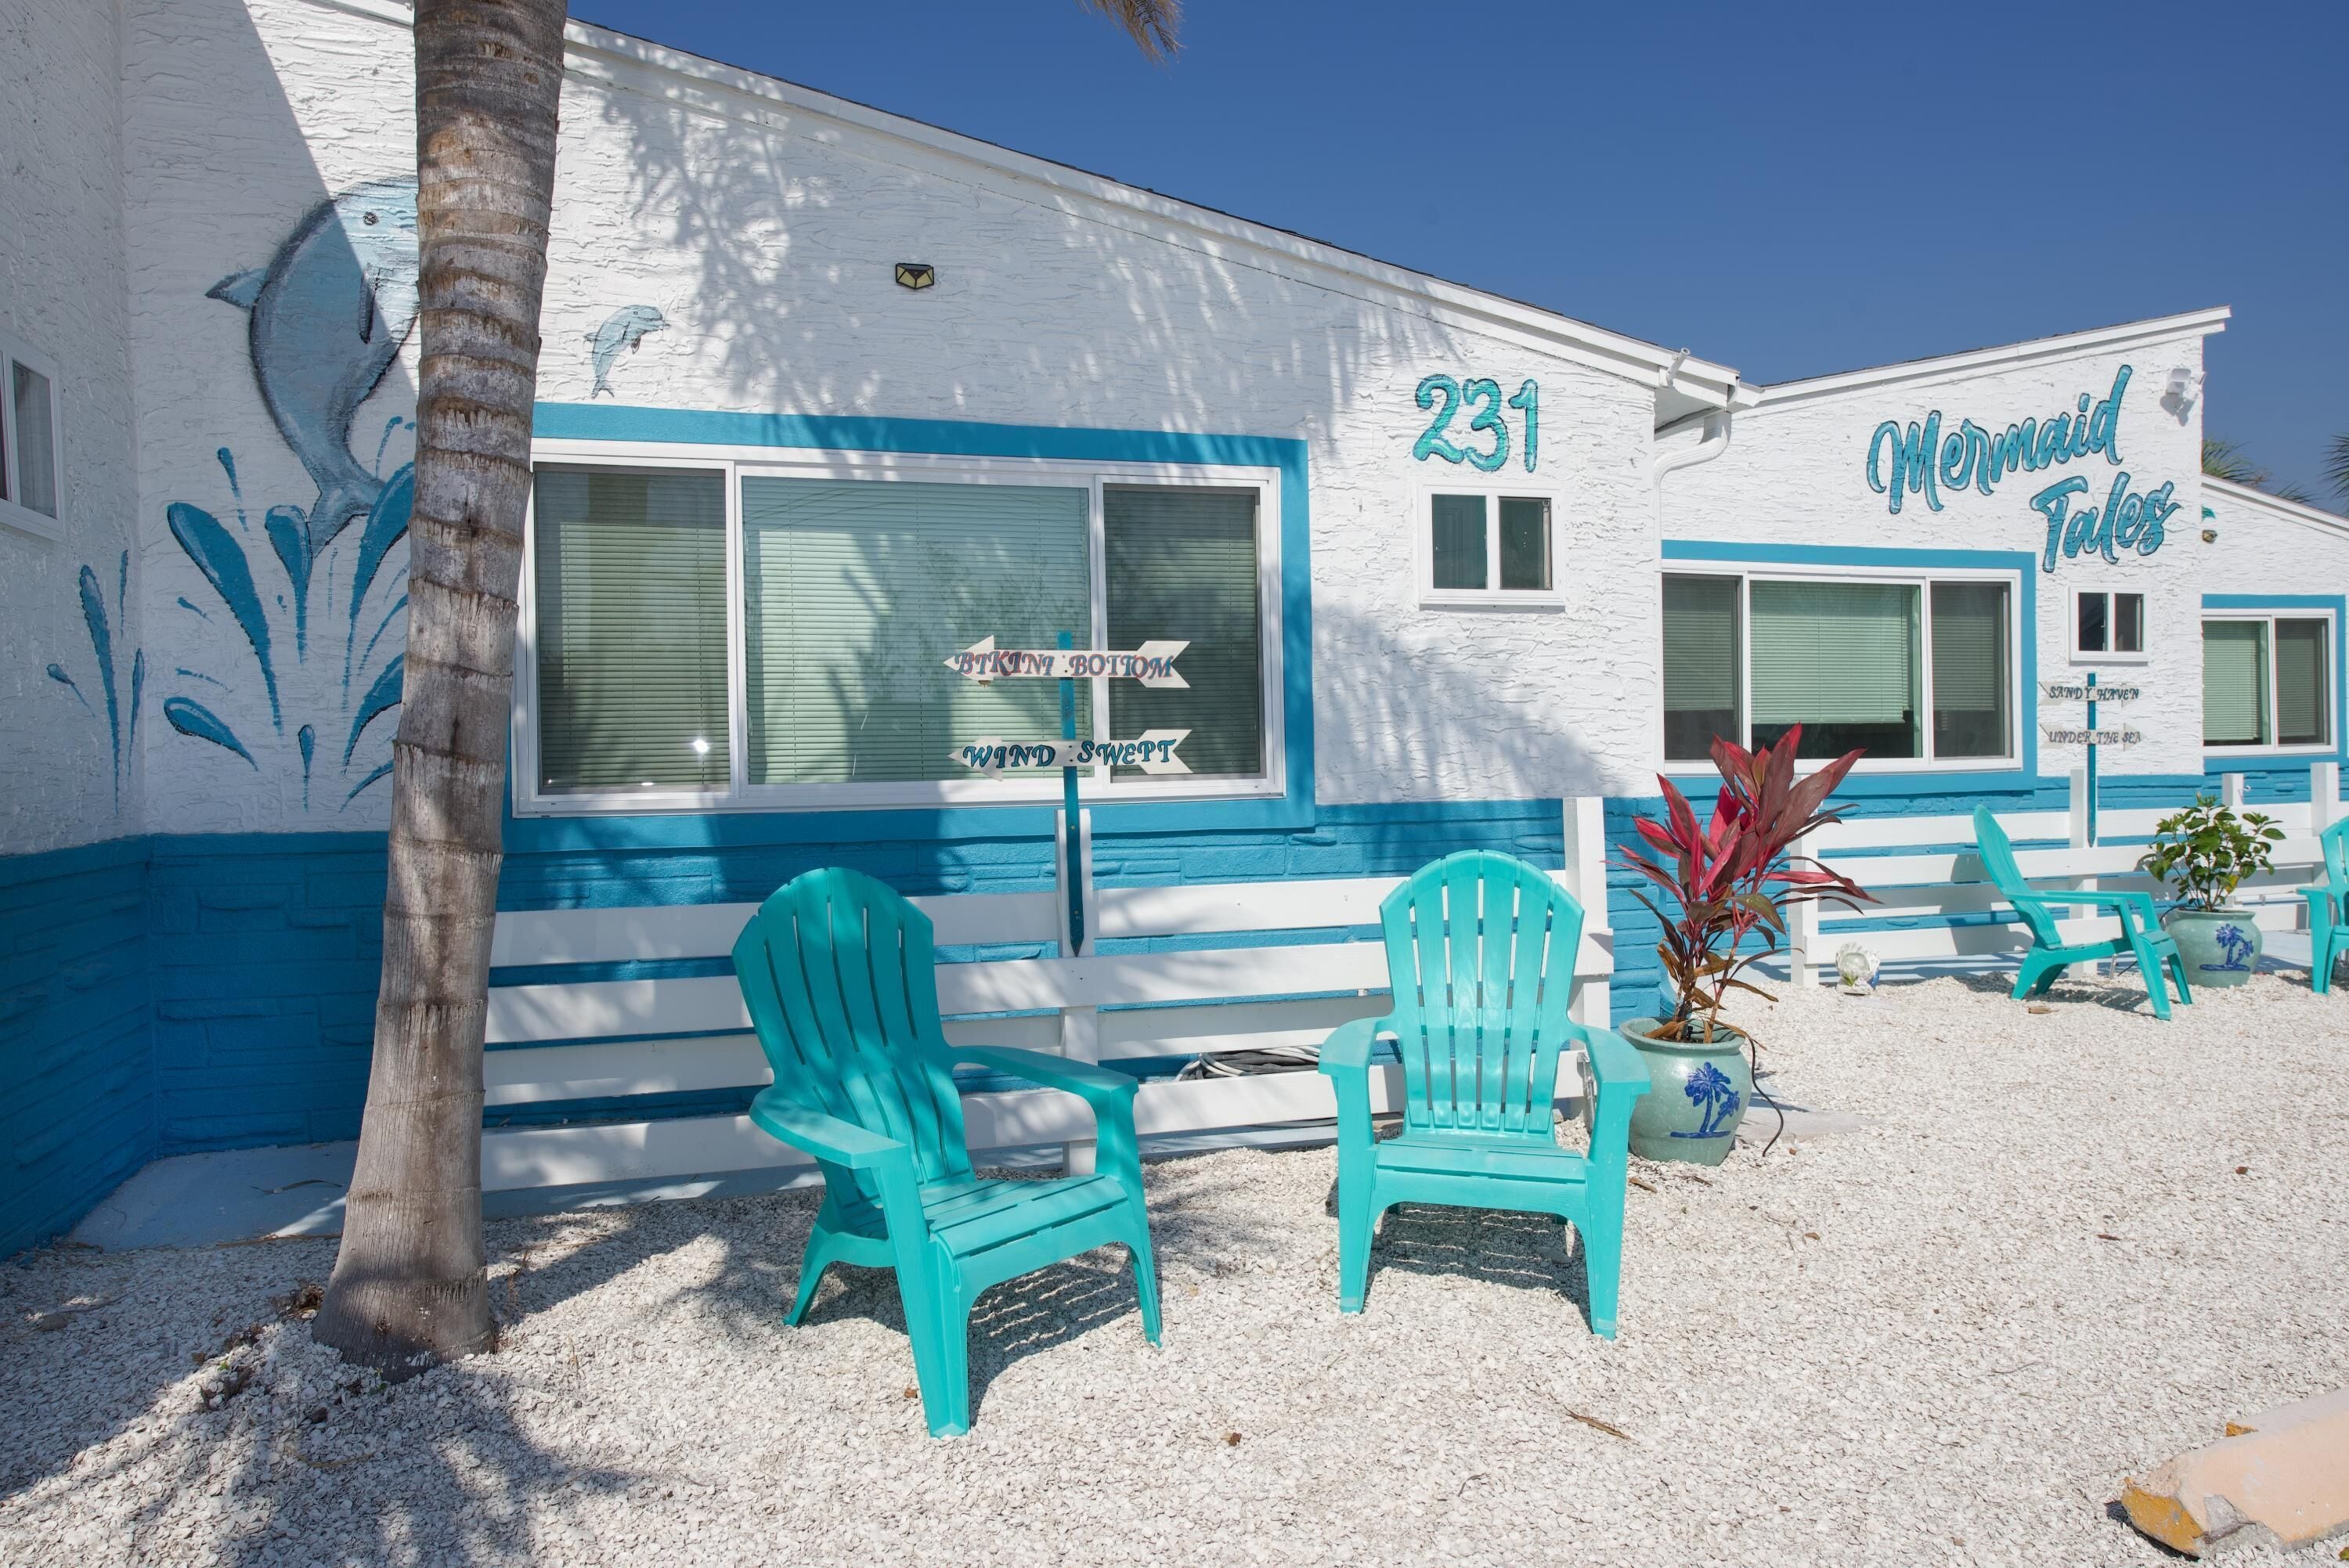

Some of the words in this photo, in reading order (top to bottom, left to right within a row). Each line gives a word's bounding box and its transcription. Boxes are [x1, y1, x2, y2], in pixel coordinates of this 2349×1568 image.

[1413, 373, 1539, 473] 231
[1867, 364, 2133, 514] Mermaid
[2030, 471, 2181, 572] Tales
[954, 651, 1055, 676] BIKINI
[1069, 654, 1174, 679] BOTTOM
[2049, 686, 2091, 699] SANDY
[2097, 688, 2139, 701] HAVEN
[2049, 731, 2091, 743] UNDER
[2097, 732, 2118, 744] THE
[2122, 731, 2141, 744] SEA
[962, 744, 1055, 768] WIND
[1077, 738, 1177, 765] SWEPT
